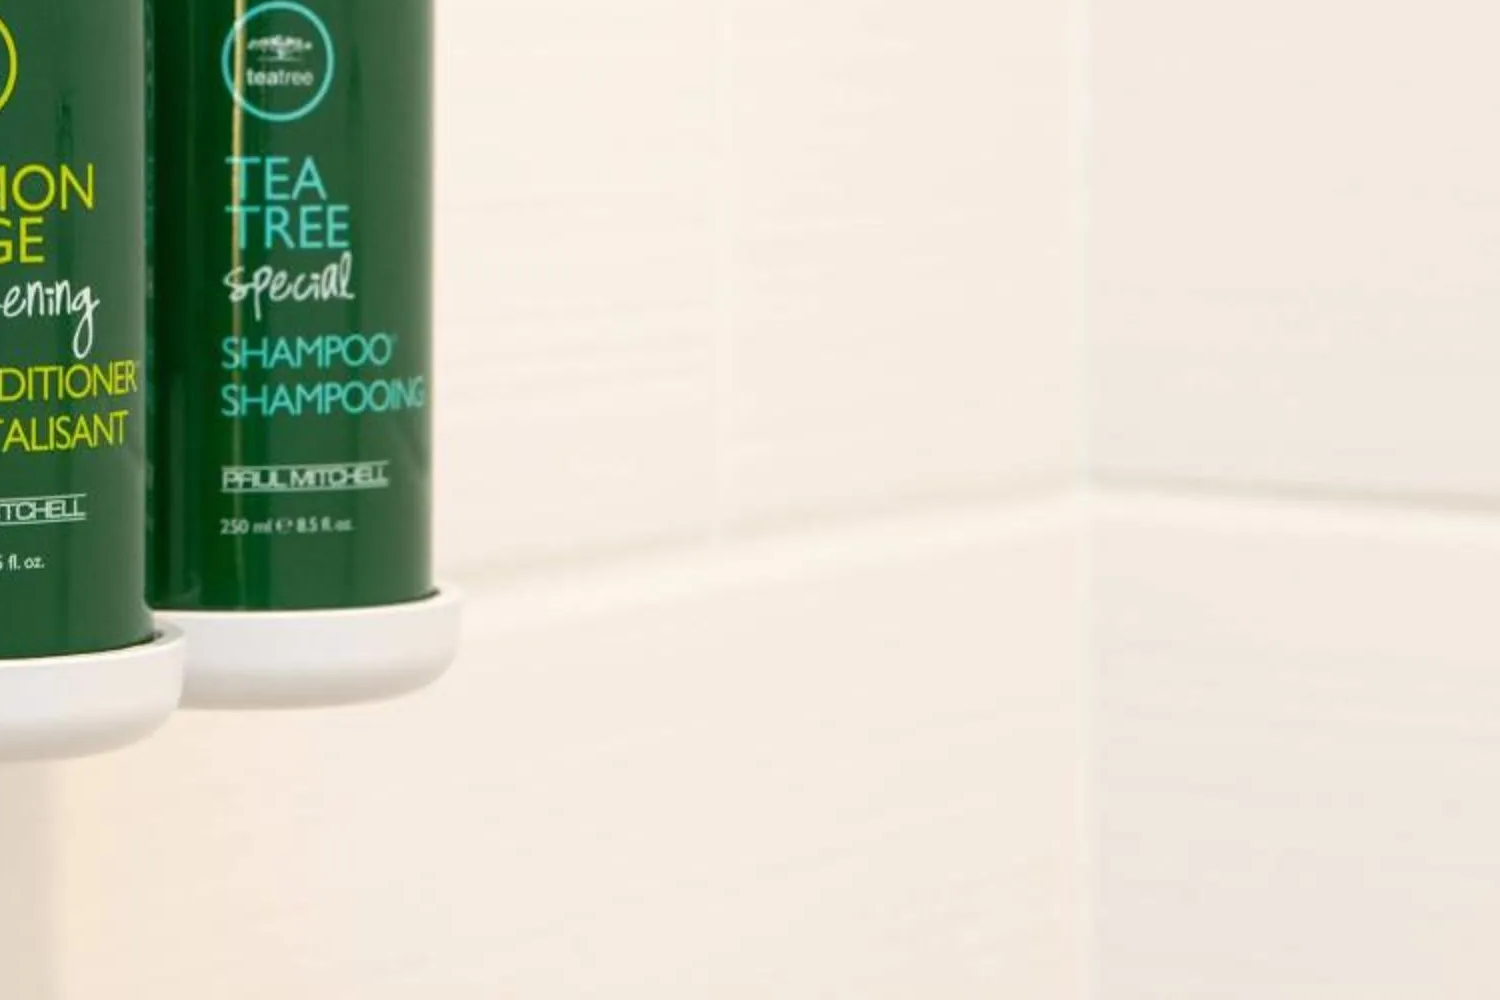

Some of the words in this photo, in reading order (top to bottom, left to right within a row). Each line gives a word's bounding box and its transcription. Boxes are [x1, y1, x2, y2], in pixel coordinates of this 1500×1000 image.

[246, 69, 314, 86] teatree
[225, 155, 328, 201] TEA
[224, 204, 350, 249] TREE
[223, 251, 355, 322] special
[221, 333, 392, 370] SHAMPOO
[221, 375, 425, 416] SHAMPOOING
[222, 470, 288, 489] PAUL
[290, 464, 389, 488] MITCHELL
[220, 518, 249, 535] 250
[253, 519, 272, 534] ml
